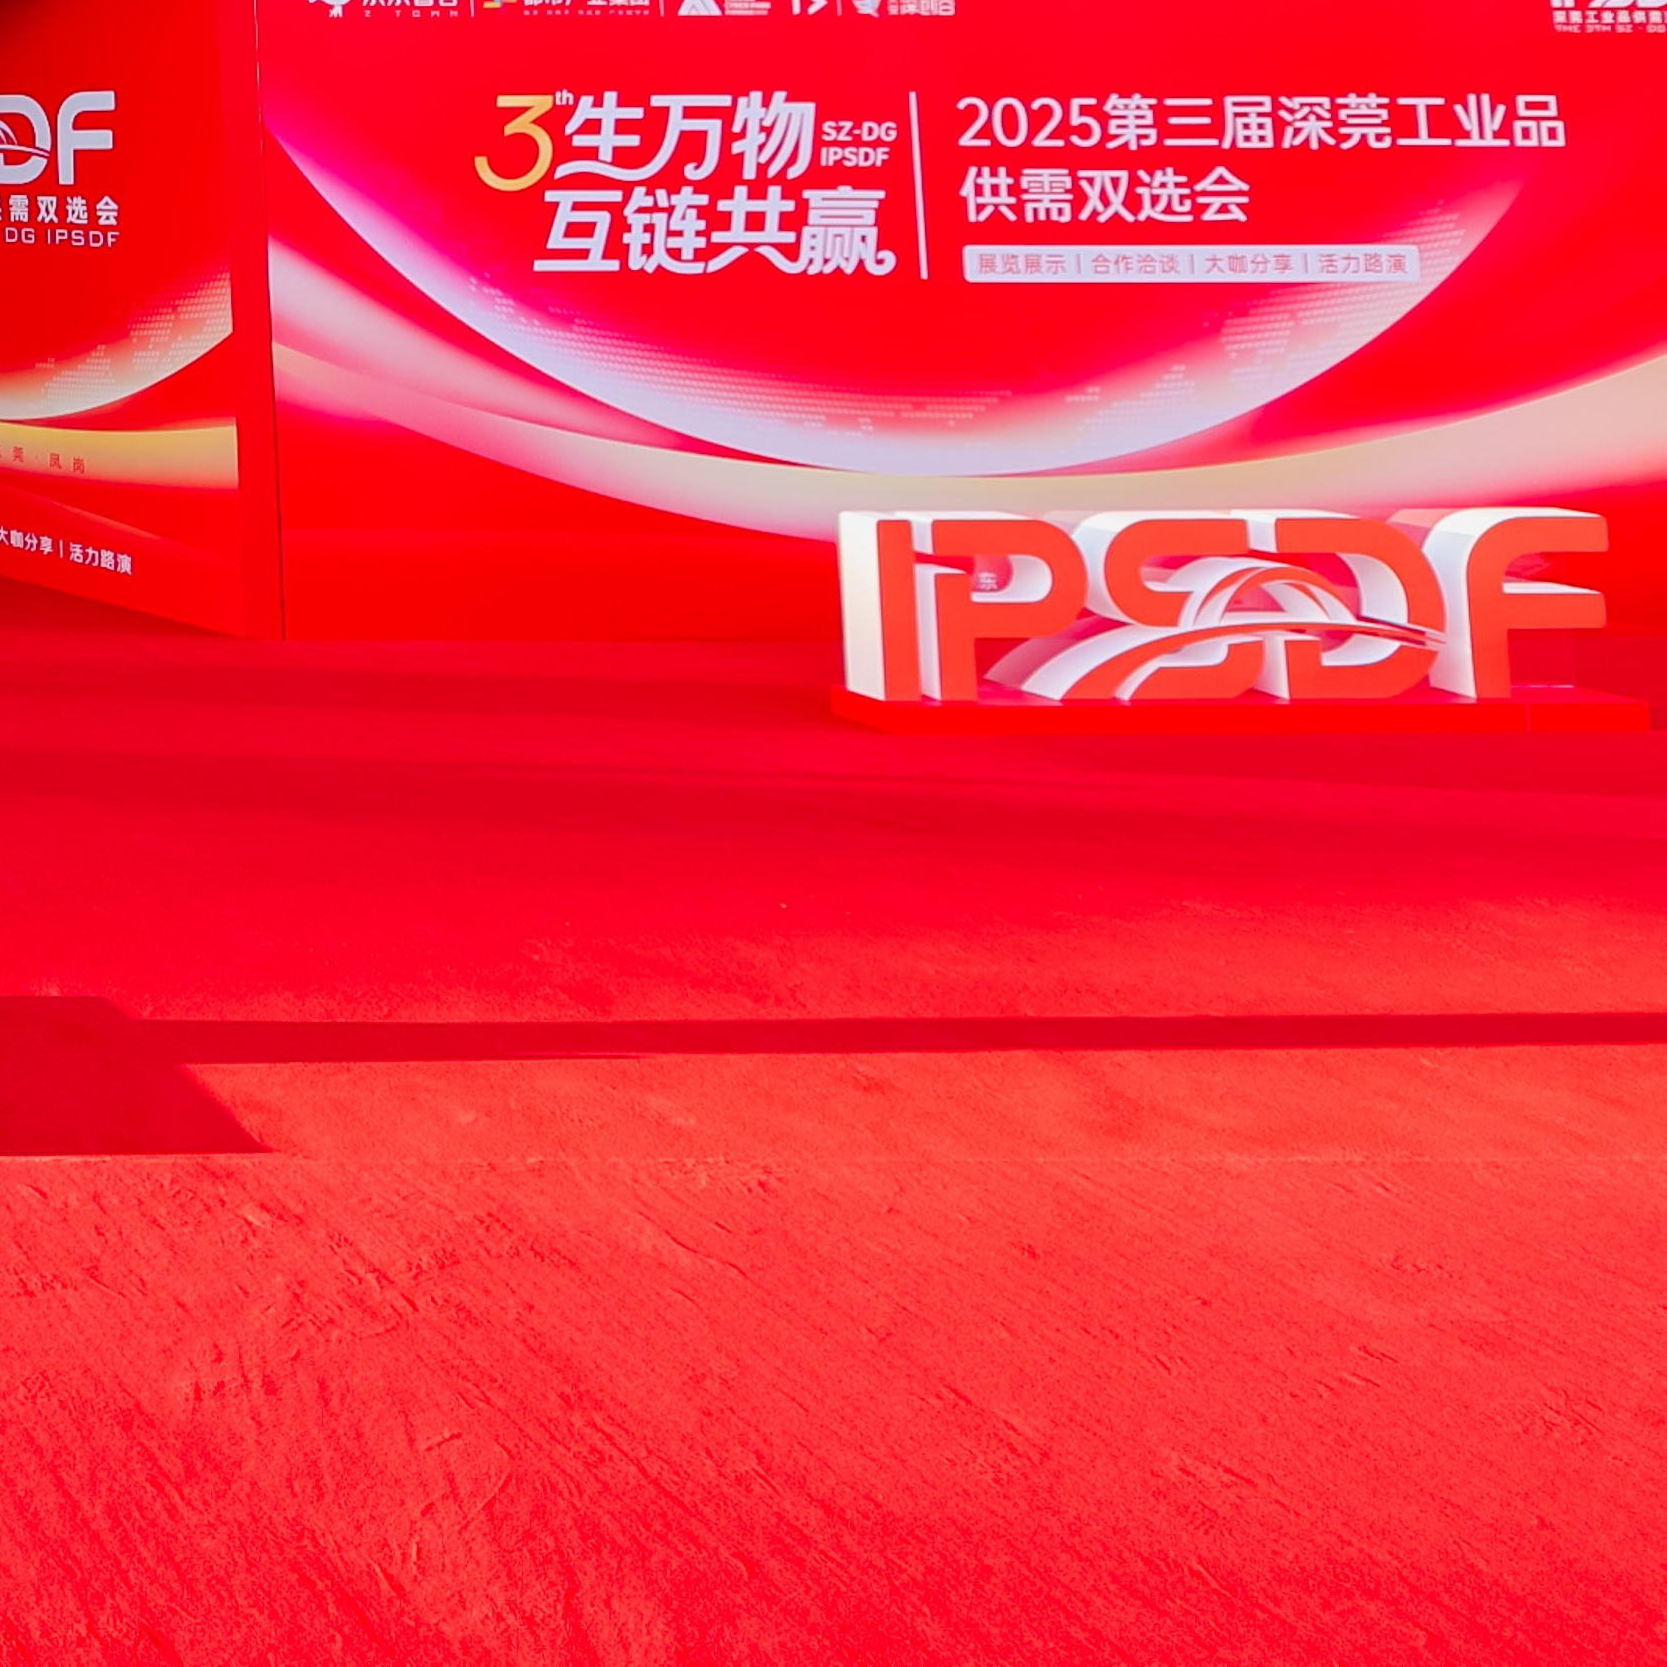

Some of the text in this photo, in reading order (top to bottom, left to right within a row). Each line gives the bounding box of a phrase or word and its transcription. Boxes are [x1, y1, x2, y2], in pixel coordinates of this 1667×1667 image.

[820, 120, 897, 142] SZ-DG
[956, 92, 1567, 151] 2025第三届深莞工业品
[820, 145, 890, 167] IPSDF
[959, 165, 1251, 223] 供需双选会
[47, 228, 120, 248] IPSDF
[533, 184, 897, 277] 互链共赢
[977, 252, 1409, 276] 展览展示 合作洽谈 大咖分享 活力路演
[69, 541, 133, 575] 活力路演
[838, 507, 1609, 704] IPSDF
